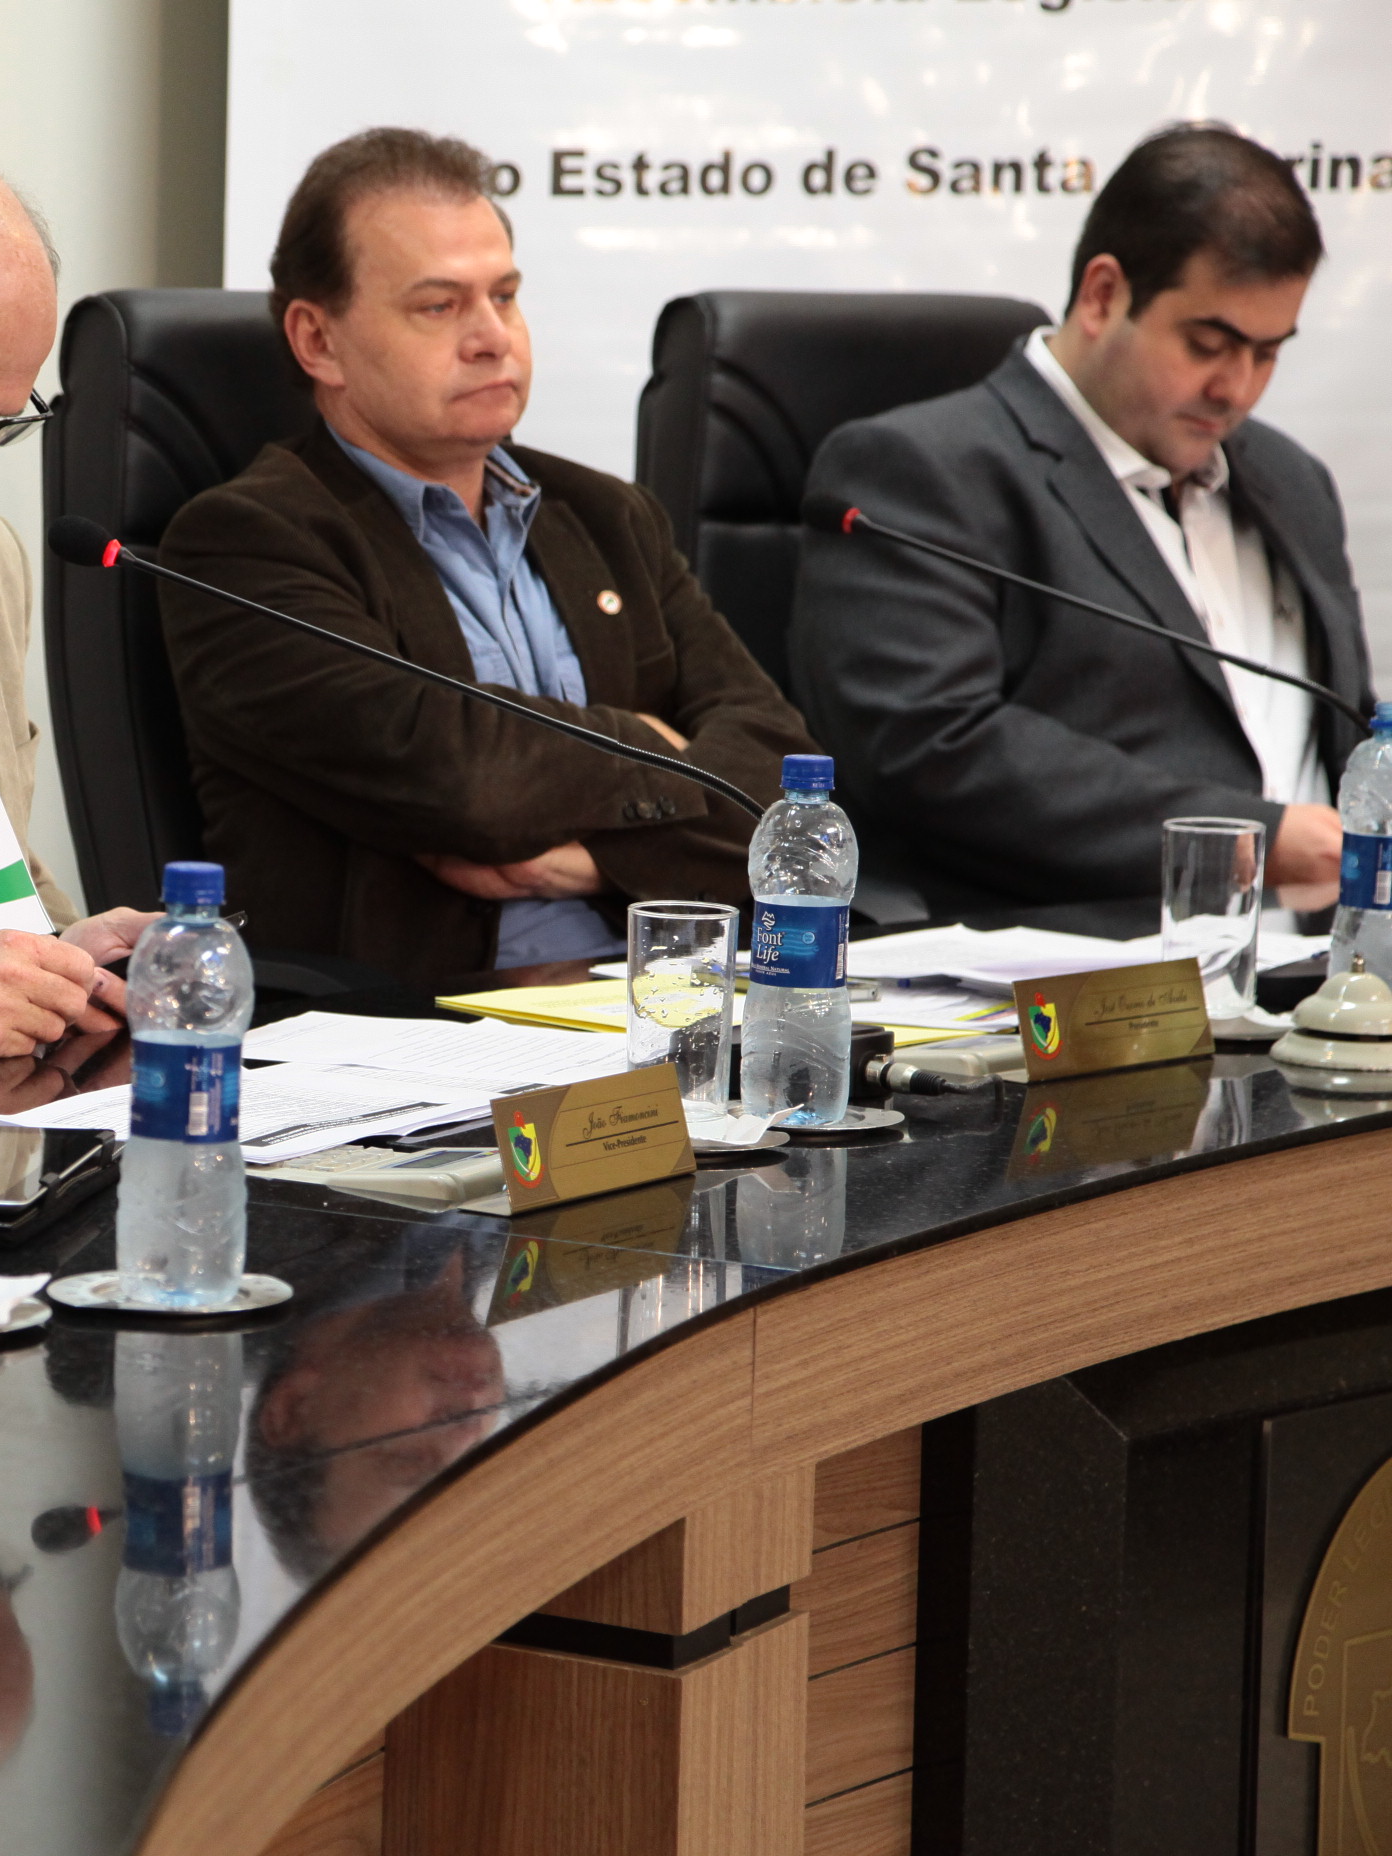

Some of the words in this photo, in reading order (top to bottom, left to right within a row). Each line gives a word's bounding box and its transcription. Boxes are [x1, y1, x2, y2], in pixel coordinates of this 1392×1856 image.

[551, 149, 773, 197] Estado
[802, 148, 878, 195] de
[906, 146, 1095, 195] Santa
[757, 927, 782, 946] Font
[756, 944, 779, 964] Life
[582, 1111, 607, 1139] João
[603, 1134, 647, 1152] Vice-Presidente
[1302, 1580, 1348, 1717] PODER
